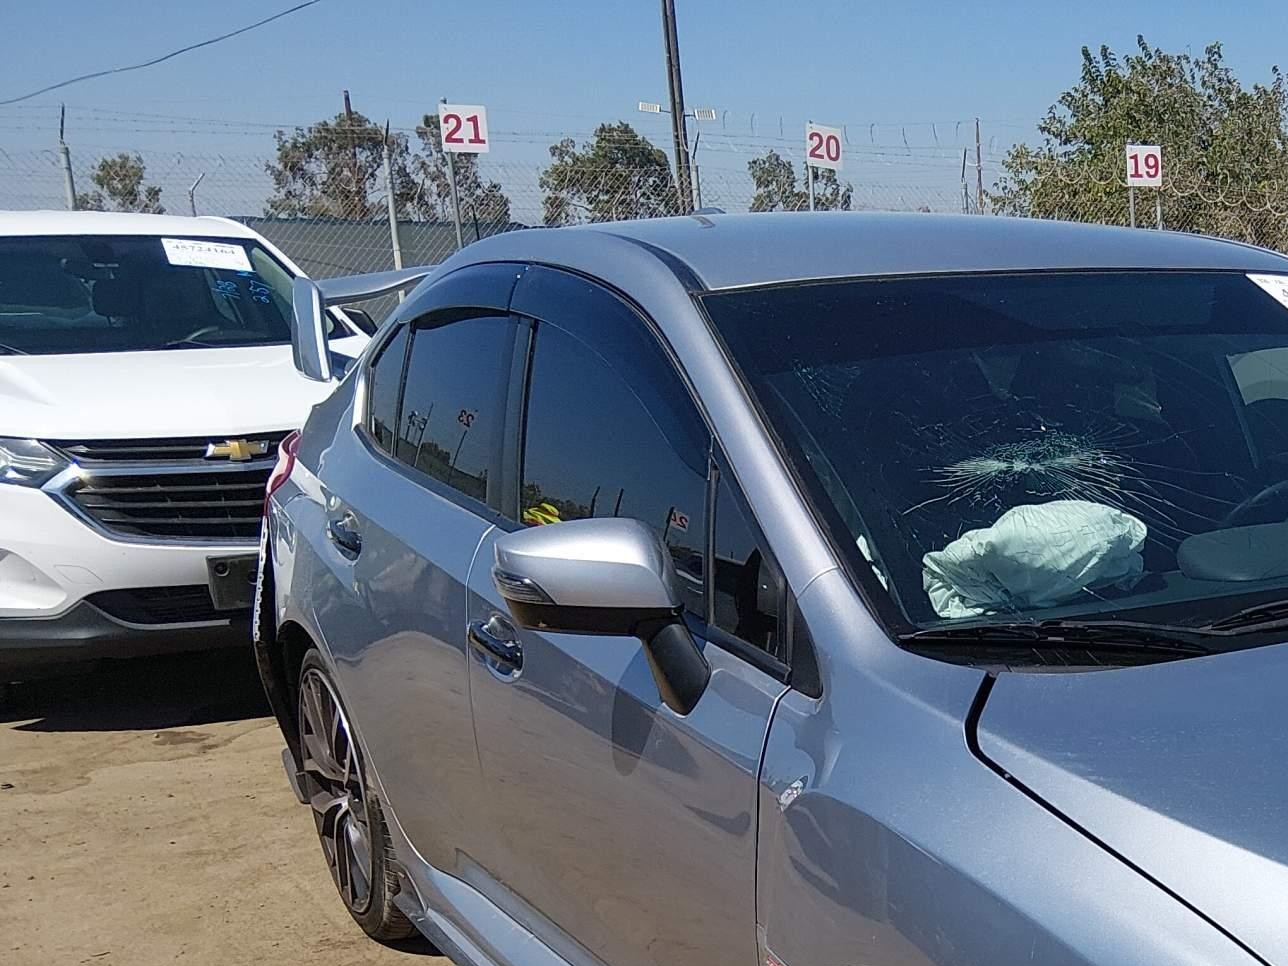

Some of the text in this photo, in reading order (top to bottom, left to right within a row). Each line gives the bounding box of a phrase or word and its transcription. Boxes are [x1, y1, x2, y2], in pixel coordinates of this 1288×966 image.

[443, 113, 486, 144] 21
[808, 132, 840, 161] 20
[1128, 153, 1159, 178] 19
